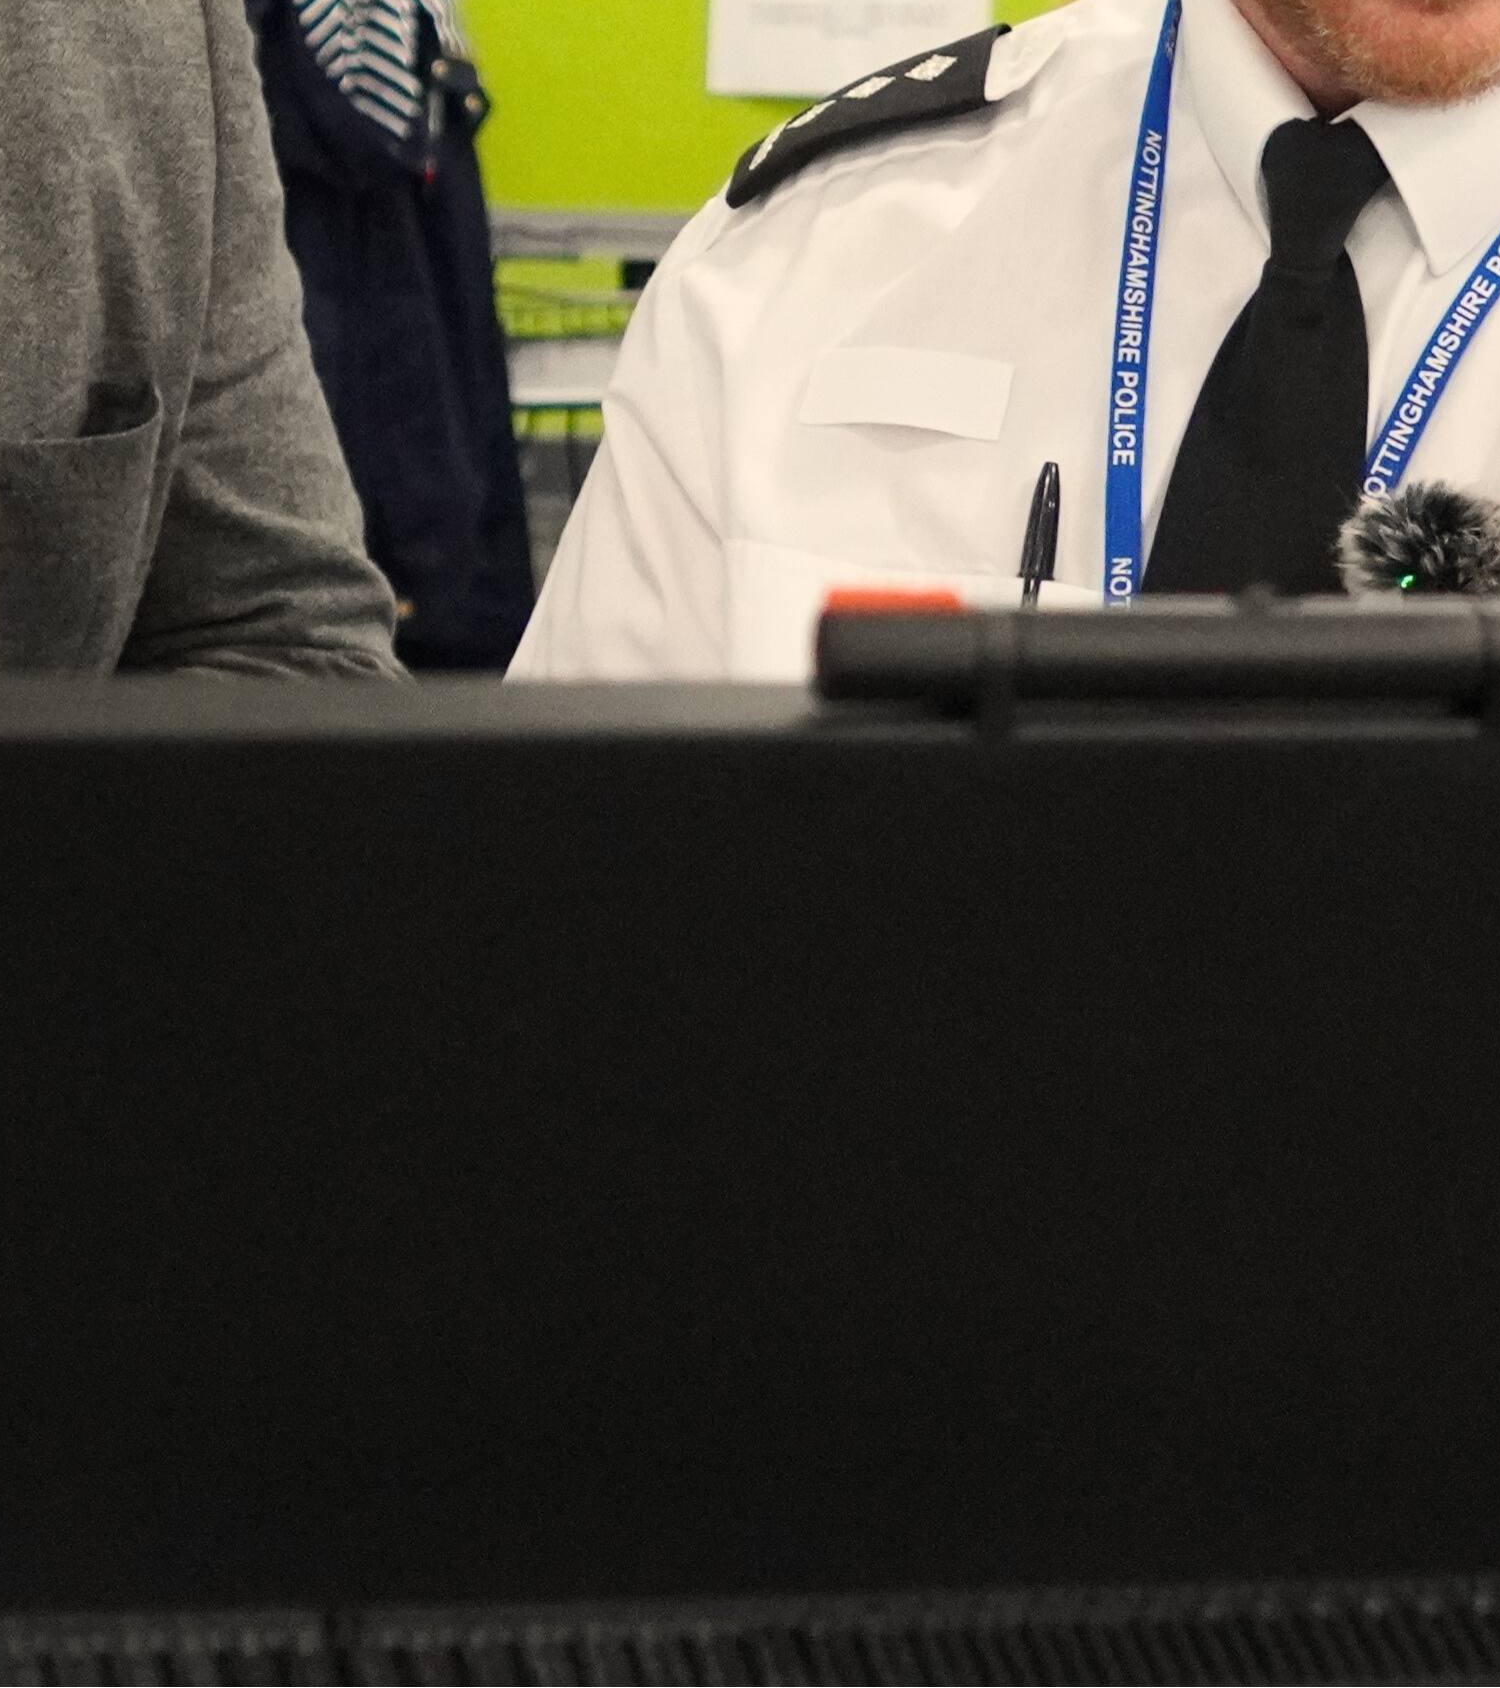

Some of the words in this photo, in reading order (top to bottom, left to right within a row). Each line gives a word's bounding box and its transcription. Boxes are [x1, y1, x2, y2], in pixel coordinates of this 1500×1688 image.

[1117, 129, 1163, 364] NOTTINGHAMSHIRE
[1112, 370, 1139, 466] POLICE
[1360, 274, 1497, 504] OTTINGHAMSHIRE
